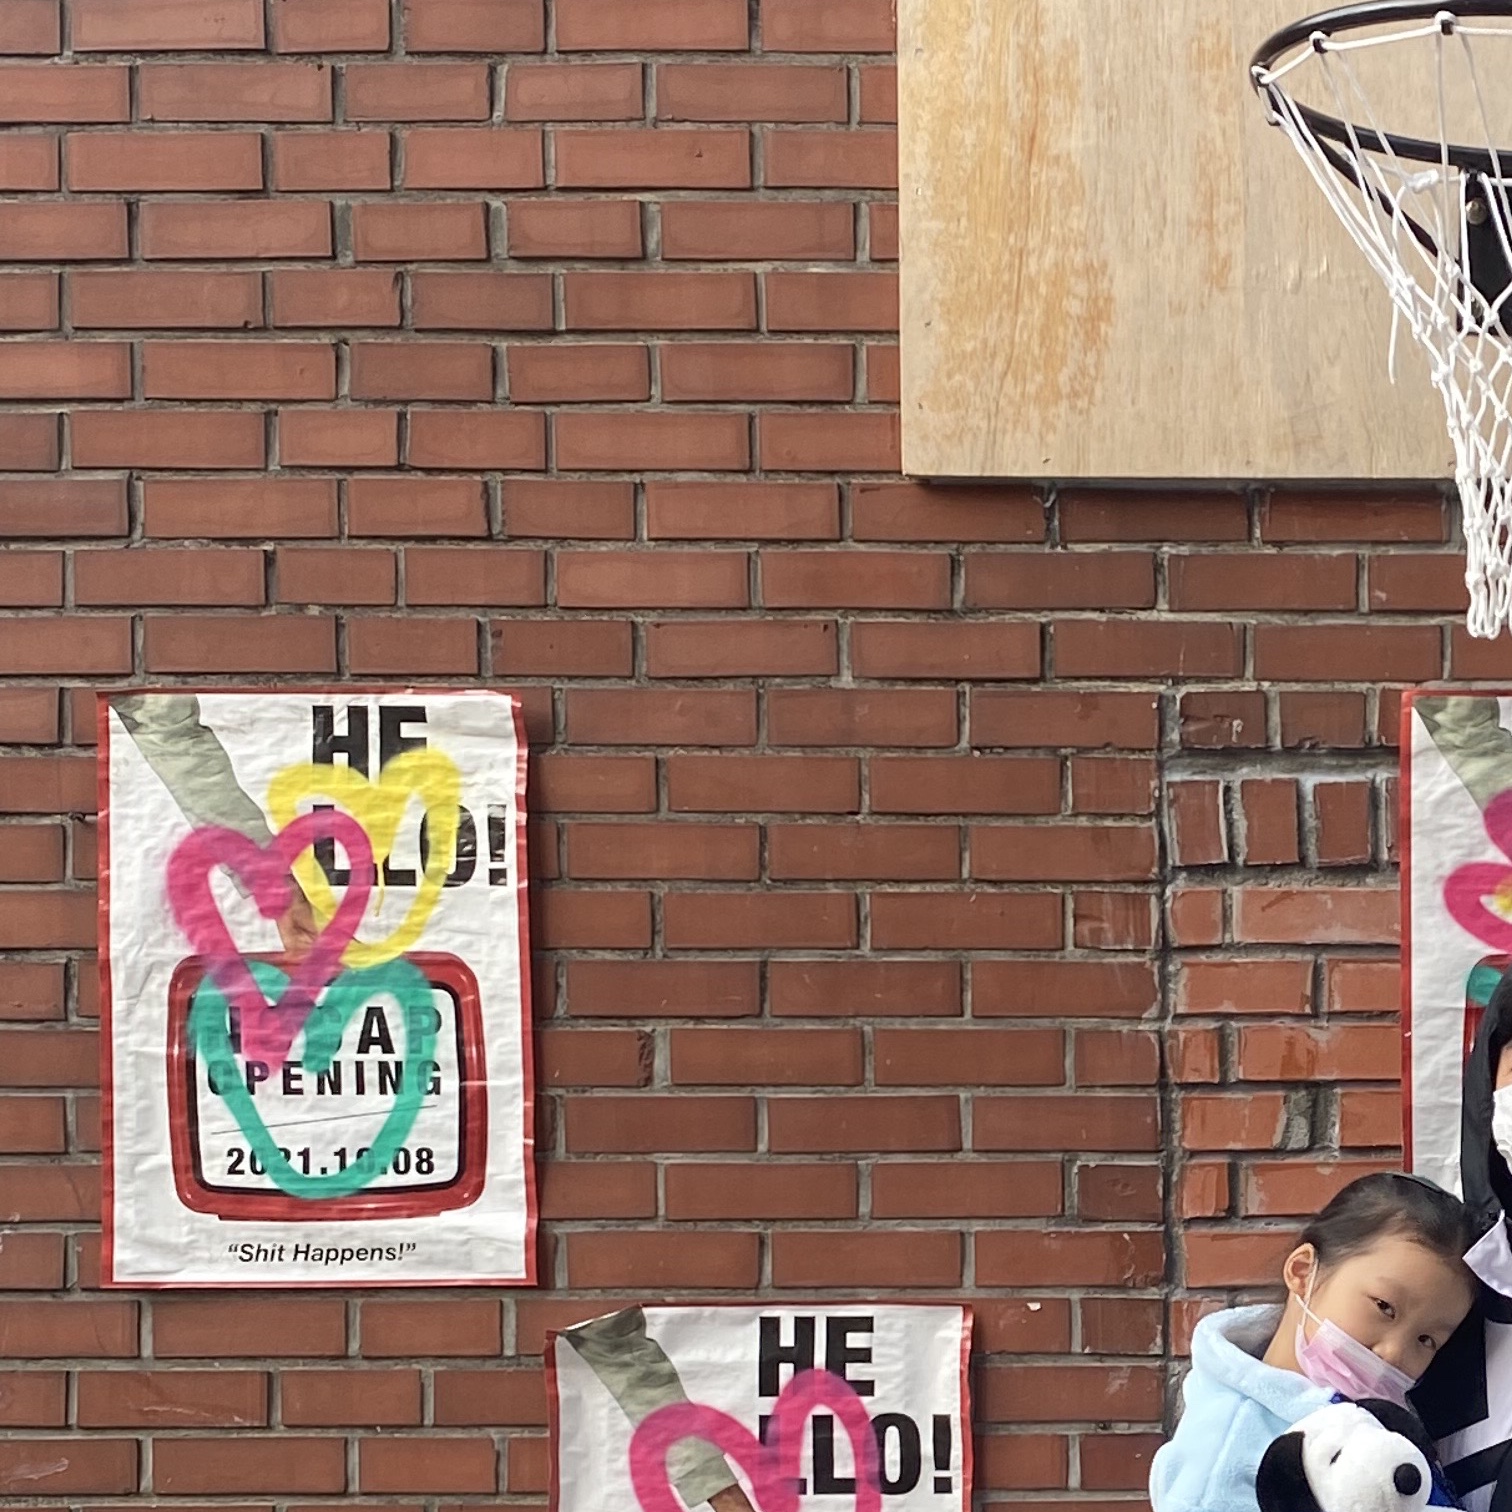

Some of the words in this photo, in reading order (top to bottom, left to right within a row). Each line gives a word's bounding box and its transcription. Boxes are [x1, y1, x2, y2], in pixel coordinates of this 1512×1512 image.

[227, 1243, 285, 1264] “Shit
[293, 1242, 417, 1267] Happens!”
[759, 1316, 875, 1397] HE
